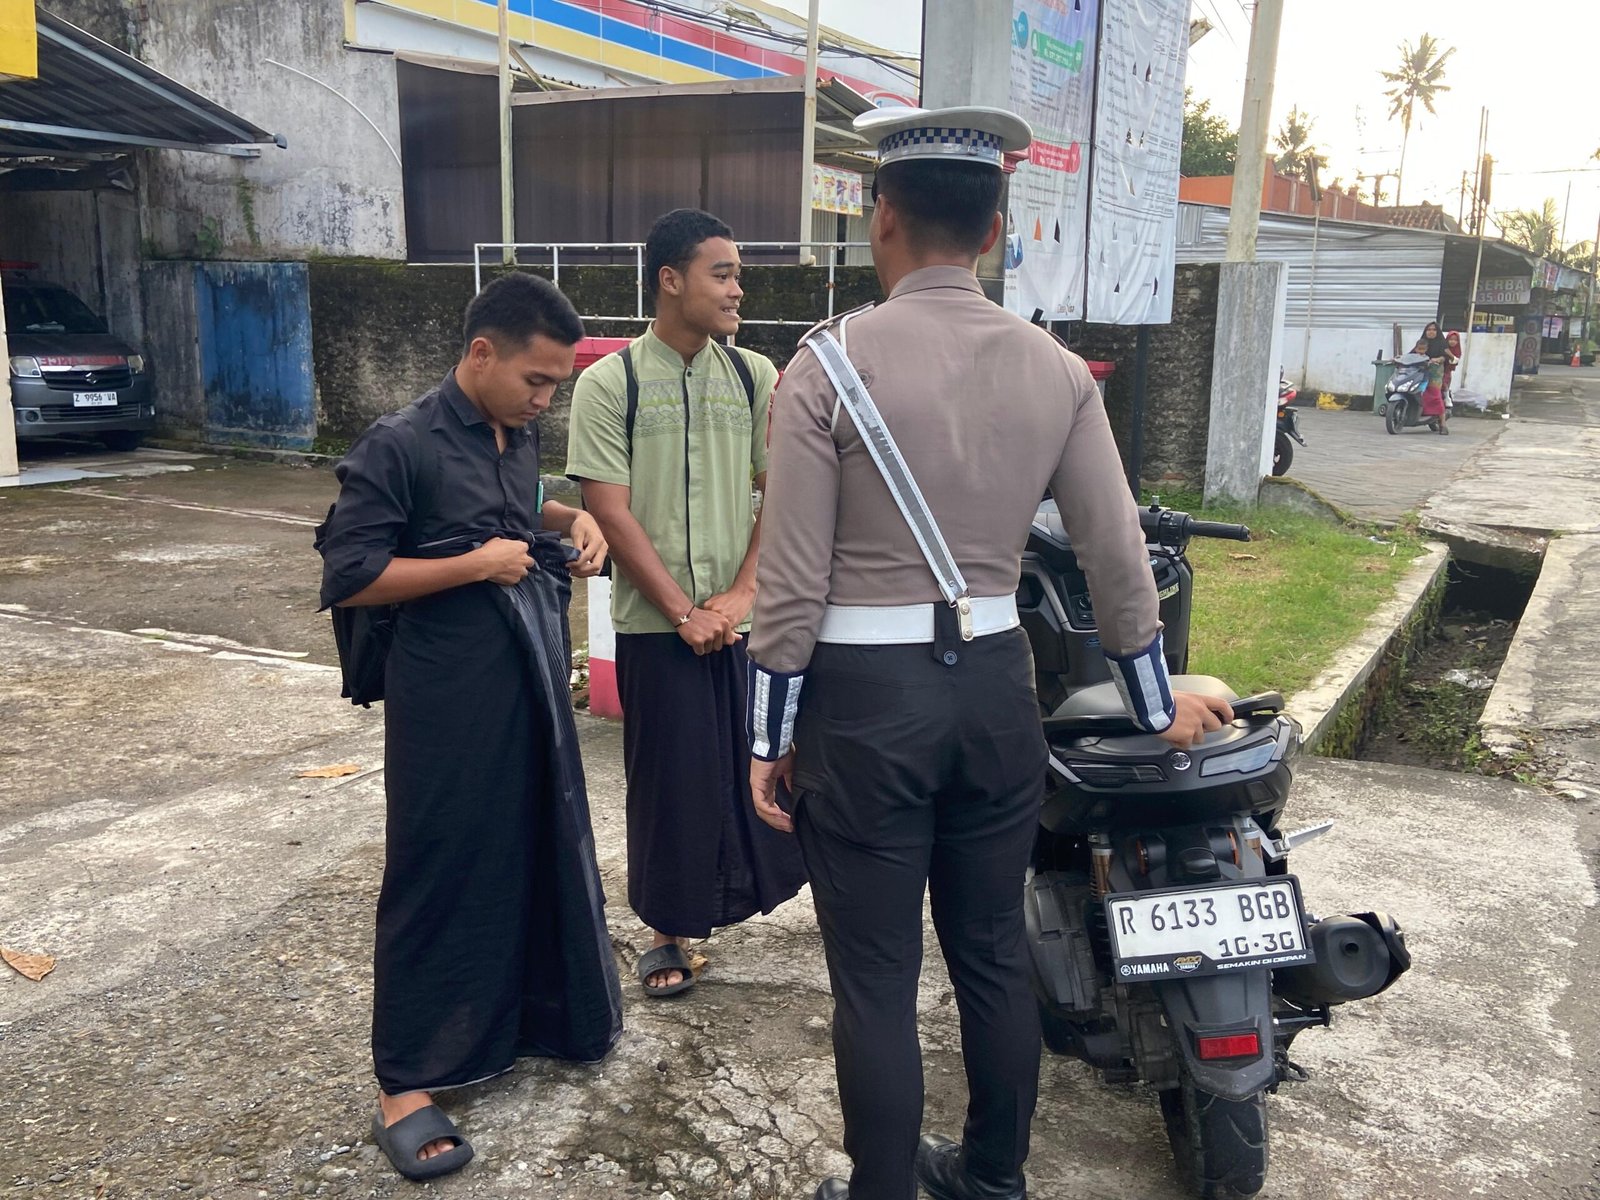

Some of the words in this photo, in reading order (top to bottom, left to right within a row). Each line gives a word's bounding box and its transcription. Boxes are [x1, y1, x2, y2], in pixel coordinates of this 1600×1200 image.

[75, 394, 80, 403] Z
[1119, 906, 1136, 935] R
[1151, 897, 1217, 932] 6133
[1237, 890, 1291, 923] BGB
[1131, 961, 1170, 976] YAMAHA
[1216, 959, 1261, 970] SEMAKIN
[1273, 954, 1307, 963] DEPAN
